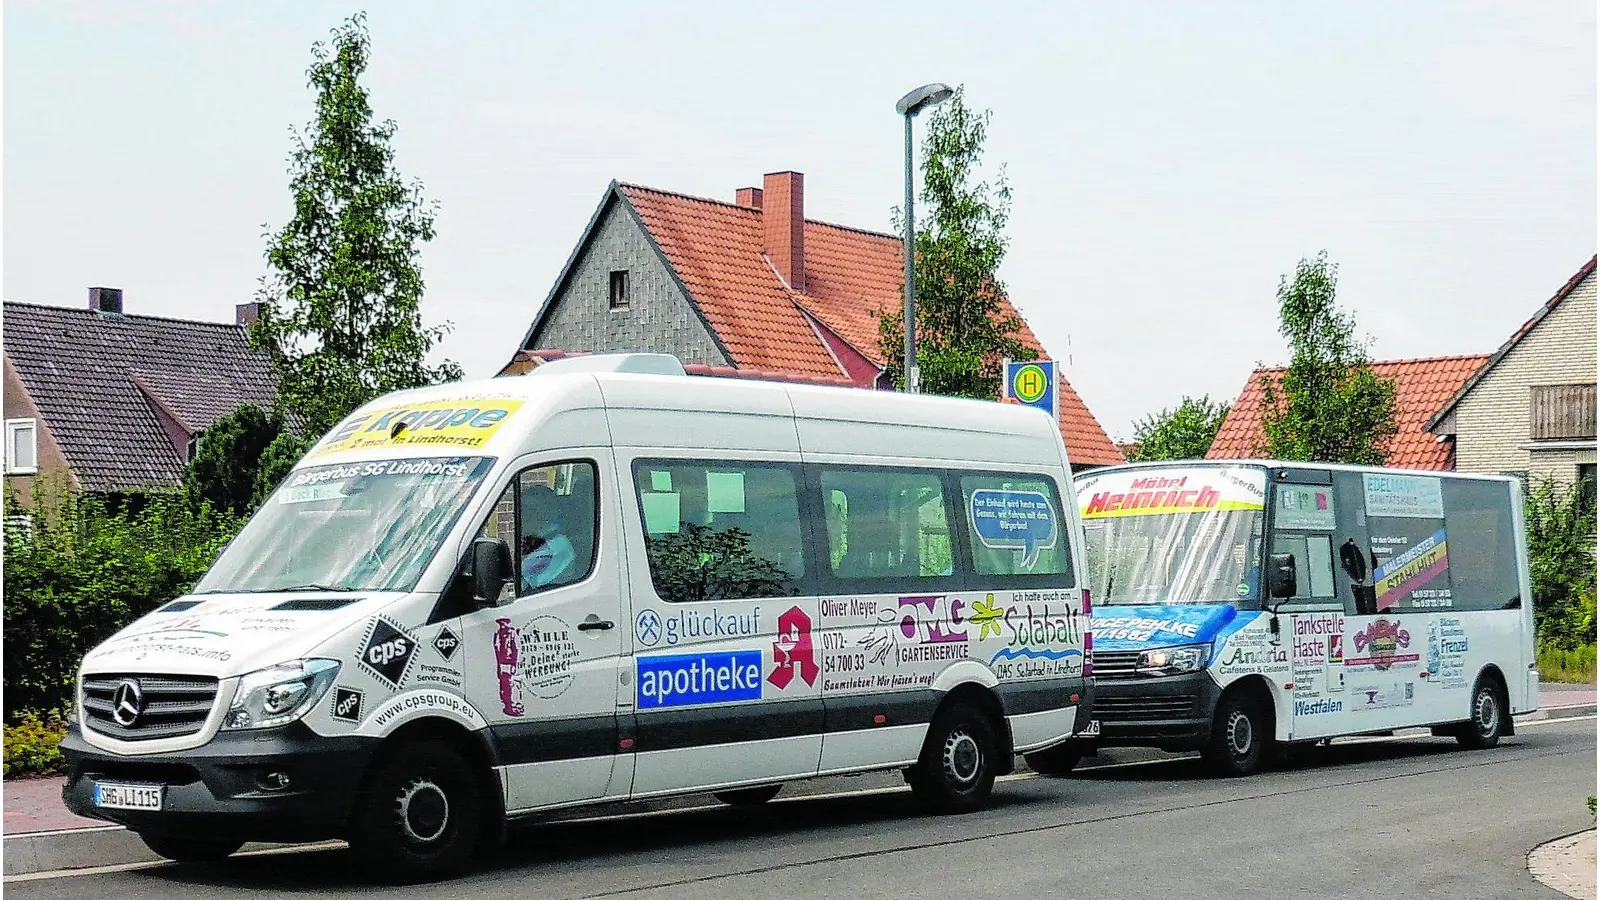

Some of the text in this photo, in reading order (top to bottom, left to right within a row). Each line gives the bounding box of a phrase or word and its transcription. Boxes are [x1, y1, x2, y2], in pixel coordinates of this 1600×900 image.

[1023, 373, 1037, 394] H
[364, 408, 509, 434] Kappe
[408, 435, 483, 446] Lindhorst!
[291, 460, 467, 487] Bürgerbus SG Lindhorst
[1131, 475, 1187, 490] Möbel
[1220, 469, 1264, 498] BrgerBus
[1086, 485, 1220, 515] Heinrich
[1012, 592, 1023, 602] Ich
[1042, 591, 1059, 601] auch
[821, 598, 877, 619] Oliver Meyer
[666, 606, 762, 645] glückauf
[1125, 618, 1200, 639] PEHLKE
[1290, 613, 1345, 636] Tankstelle
[369, 638, 407, 665] cps
[436, 637, 456, 650] cps
[901, 644, 969, 663] GARTENSERVICE
[1293, 637, 1325, 658] Haste
[824, 654, 865, 673] 54 700 33
[996, 663, 1013, 680] DAS
[416, 674, 441, 682] Service
[642, 657, 759, 704] apotheke
[337, 693, 359, 716] cps
[375, 694, 475, 726] www.cpsgroup.eu
[1294, 698, 1343, 717] Westfalen
